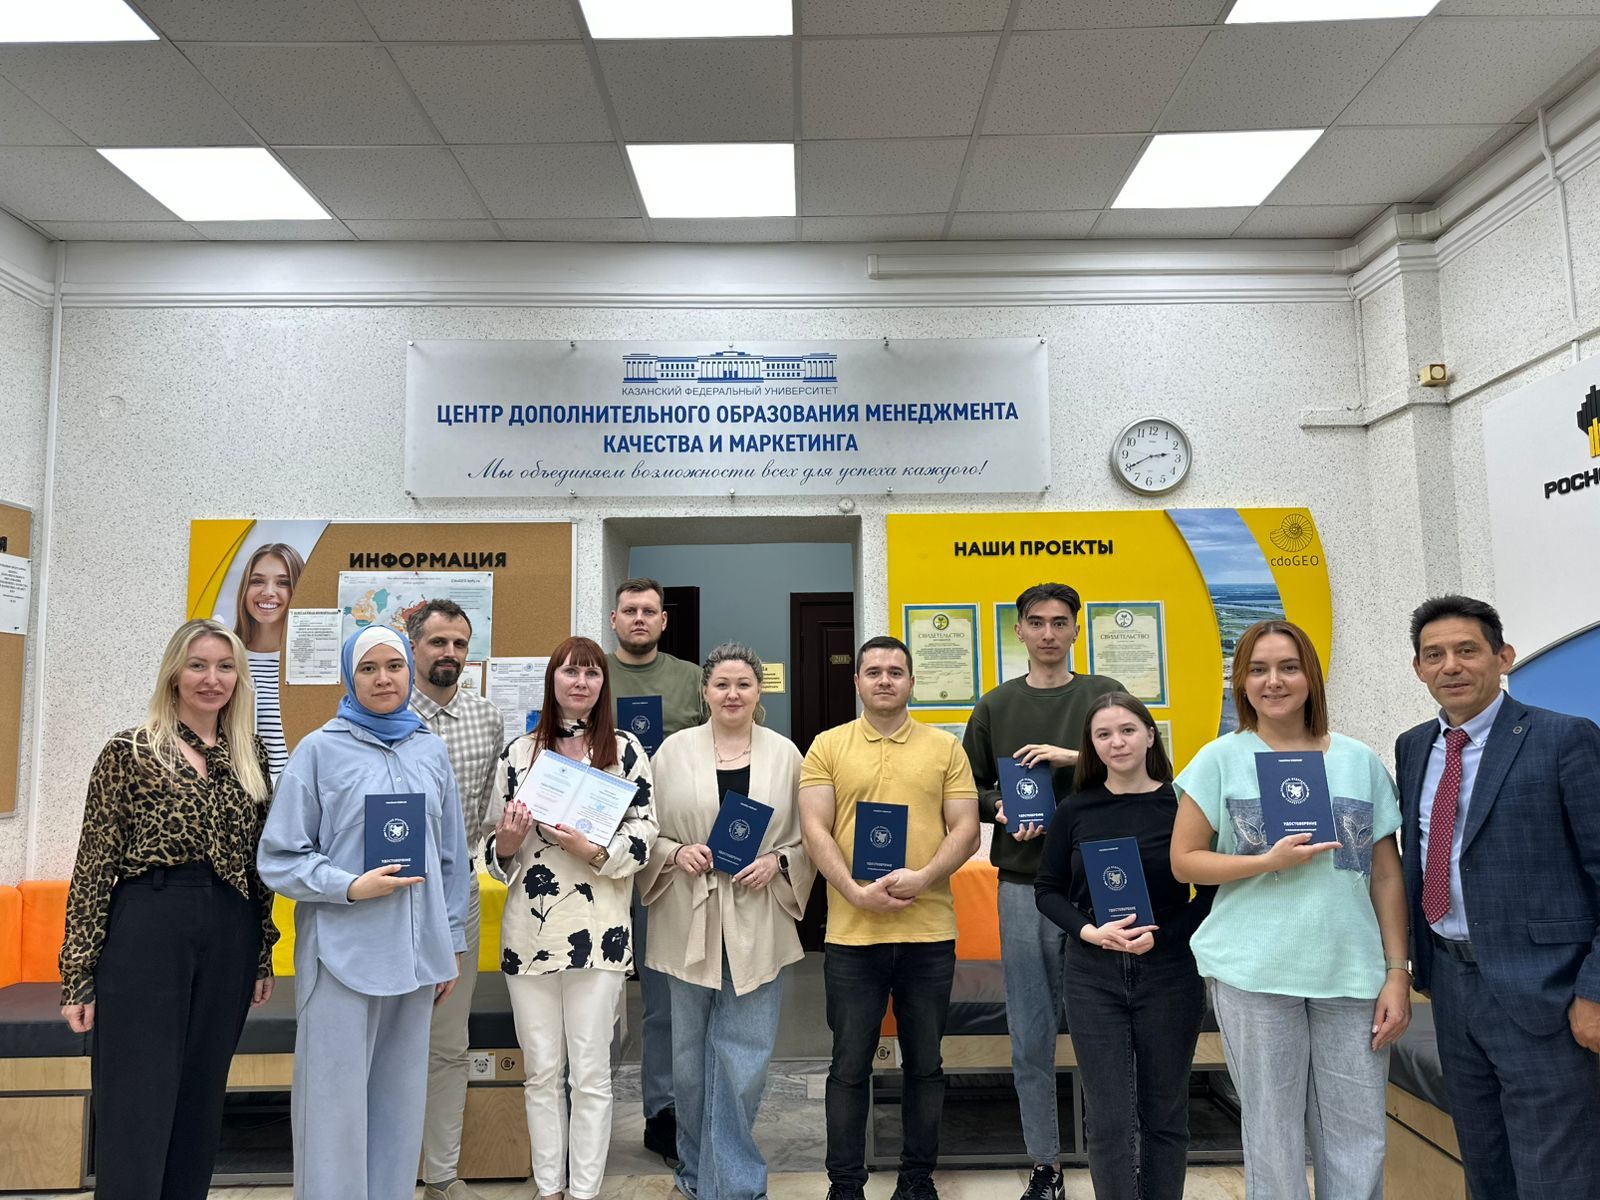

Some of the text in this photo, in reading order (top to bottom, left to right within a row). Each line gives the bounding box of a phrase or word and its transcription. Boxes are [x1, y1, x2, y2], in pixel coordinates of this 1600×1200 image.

[622, 385, 838, 397] КАЗАНСКИЙ ФЕДЕРАЛЬНЫЙ УНИВЕРСИТЕТ
[437, 402, 1019, 426] ЦЕНТР ДОПОЛНИТЕЛЬНОГО ОБРАЗОВАНИЯ МЕНЕДЖМЕНТА
[1137, 428, 1145, 438] 11
[1149, 426, 1159, 436] 12
[1165, 431, 1169, 440] 1
[603, 433, 859, 453] КАЧЕСТВА И МАРКЕТИНГА
[1126, 437, 1136, 447] 10
[1172, 440, 1179, 450] 2
[1121, 450, 1129, 459] 9
[1174, 454, 1182, 463] 3
[467, 458, 989, 487] Мы объединяем возможности всех для успеха каждого!
[1125, 463, 1132, 472] 8
[1134, 472, 1141, 482] 7
[1145, 476, 1153, 486] 6
[1159, 474, 1166, 484] 5
[1544, 467, 1600, 499] РОСН
[954, 539, 1114, 556] НАШИ ПРОЕКТЫ
[349, 551, 507, 570] ИНФОРМАЦИЯ
[1270, 555, 1319, 567] cdoGEO
